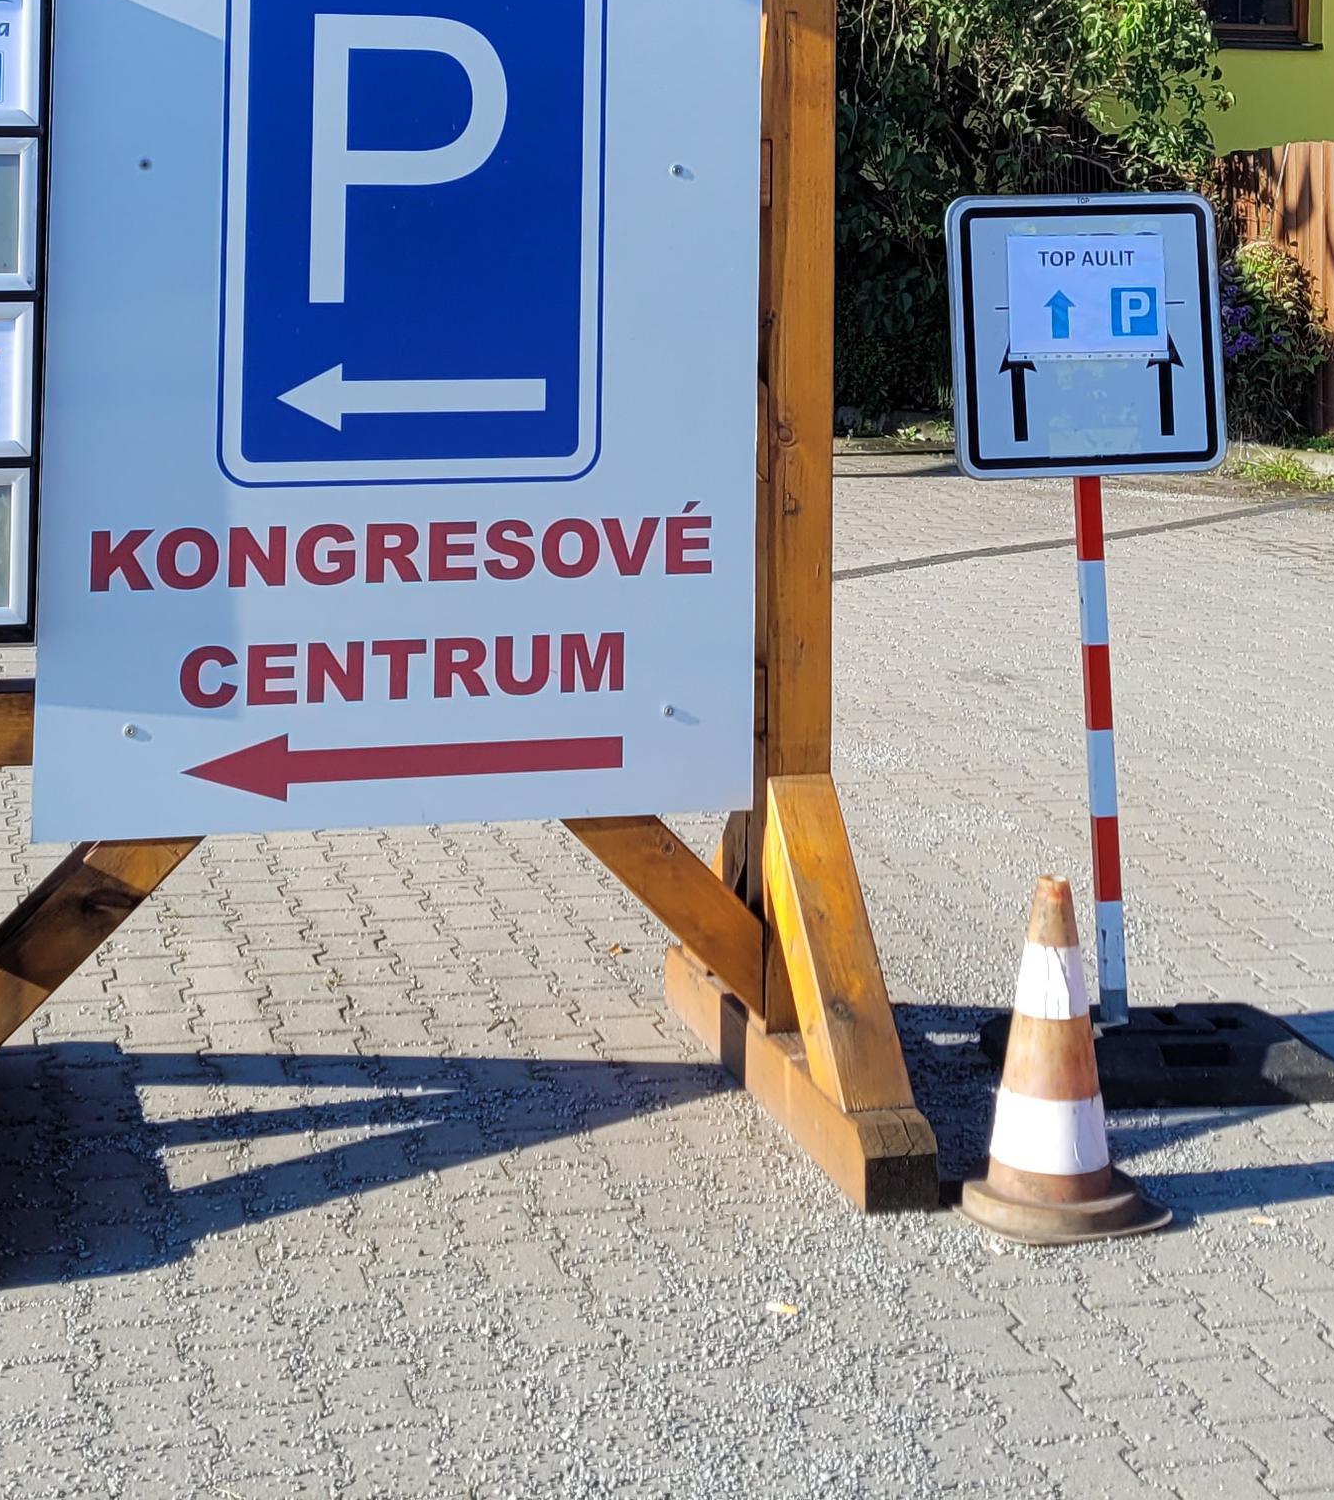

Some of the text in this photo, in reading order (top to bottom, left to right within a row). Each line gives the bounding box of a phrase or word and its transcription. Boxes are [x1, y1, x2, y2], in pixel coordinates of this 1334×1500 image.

[309, 13, 508, 303] P
[1038, 250, 1135, 267] TOP AULIT
[1120, 291, 1151, 333] P
[89, 501, 713, 592] KONGRESOVÉ
[179, 632, 626, 709] CENTRUM
